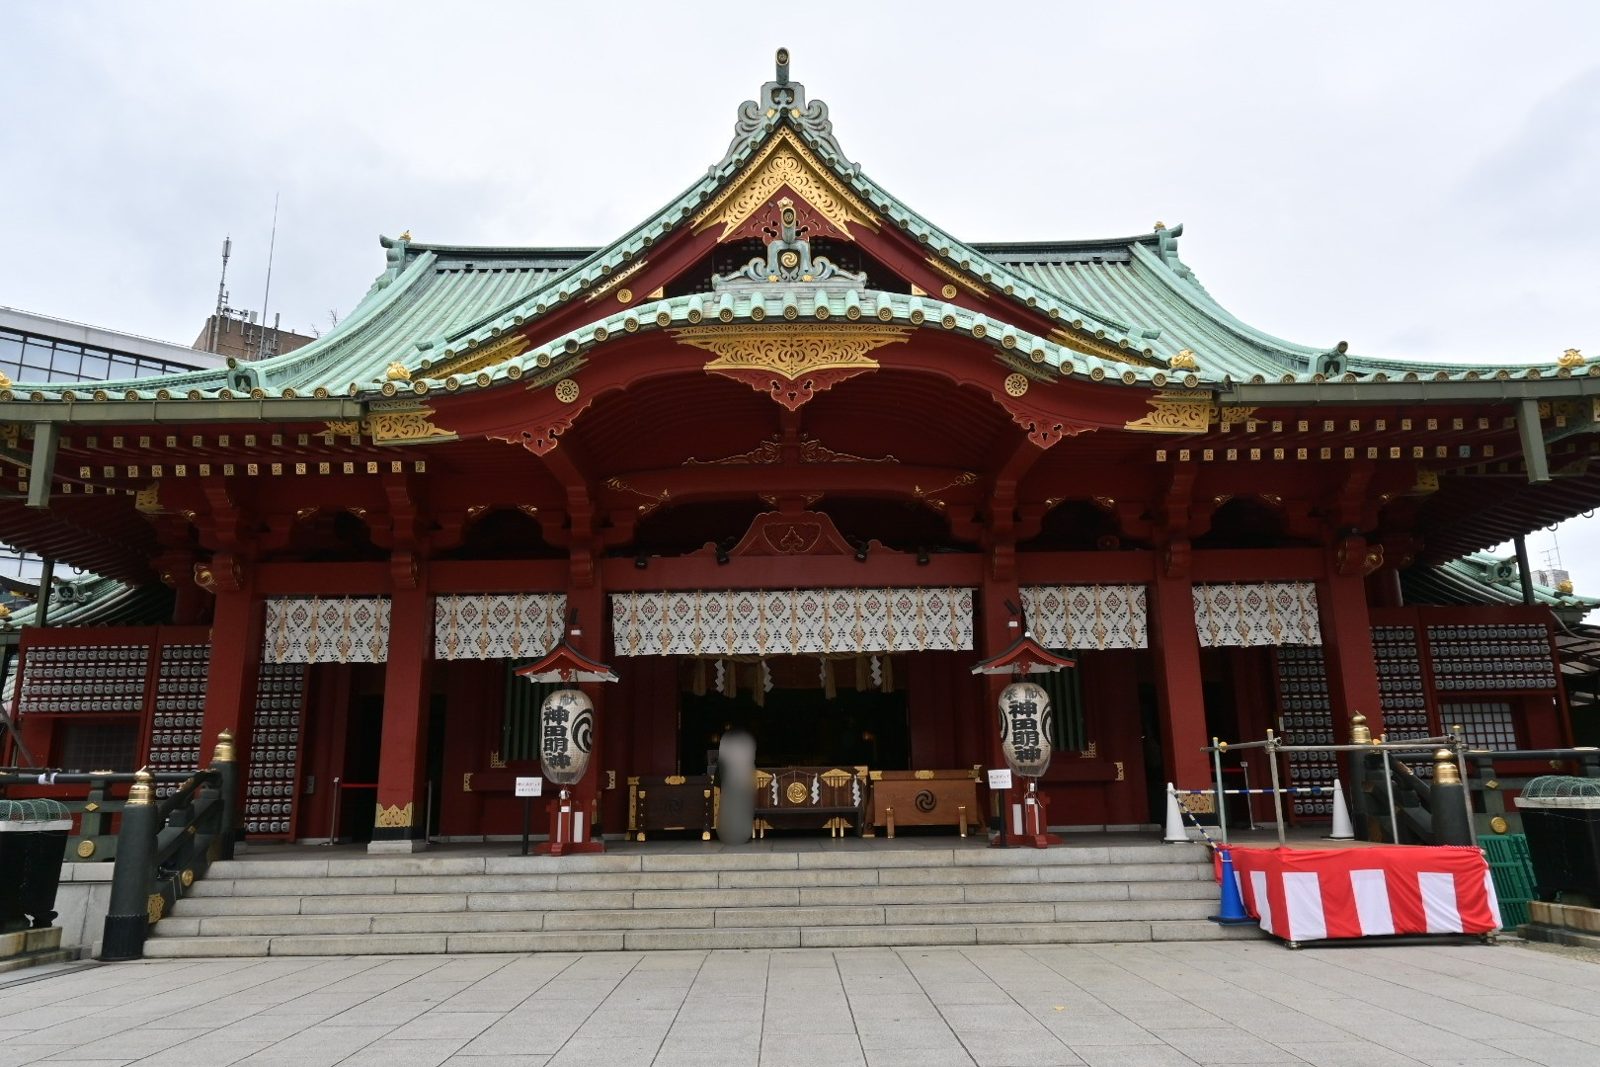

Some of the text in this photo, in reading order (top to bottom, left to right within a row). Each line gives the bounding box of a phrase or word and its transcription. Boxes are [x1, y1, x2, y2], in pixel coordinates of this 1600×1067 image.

[543, 704, 571, 769] 神田明神
[1008, 700, 1041, 763] 神田明神
